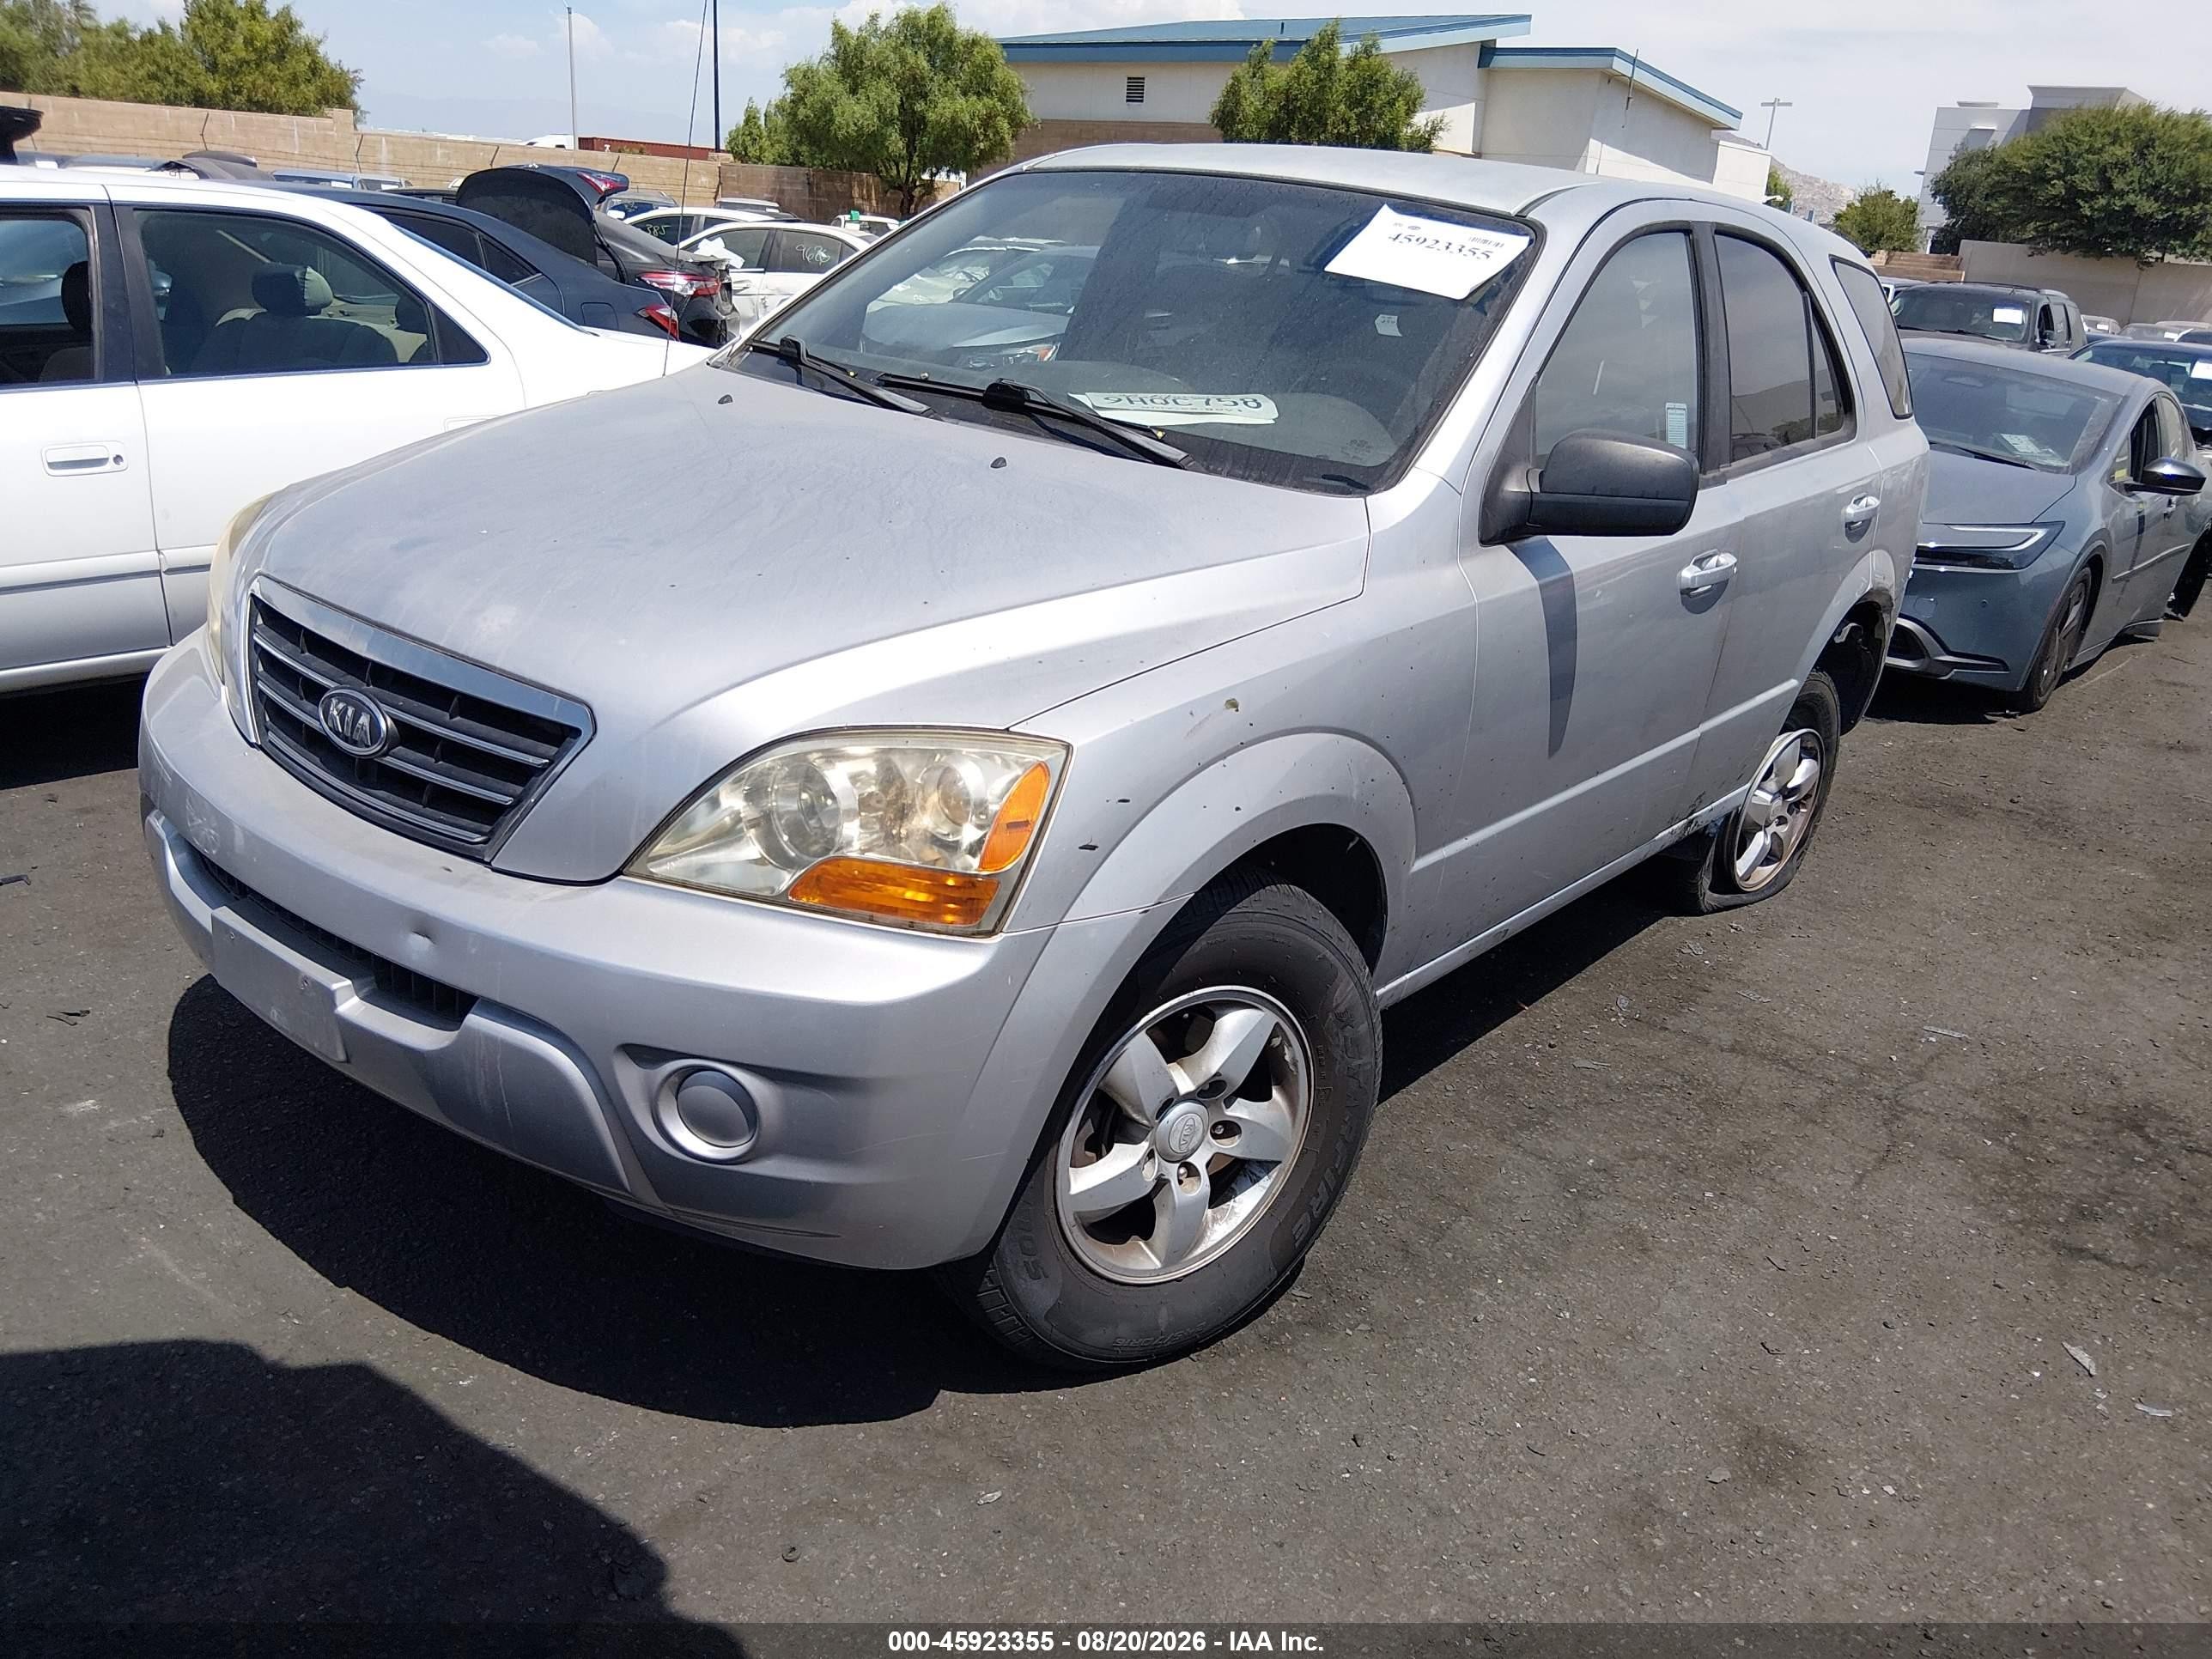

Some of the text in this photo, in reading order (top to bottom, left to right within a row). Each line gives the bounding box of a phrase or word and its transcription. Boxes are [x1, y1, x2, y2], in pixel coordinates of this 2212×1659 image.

[1388, 233, 1494, 260] 45923355
[327, 696, 373, 747] KIA
[1180, 1122, 1194, 1148] KIA
